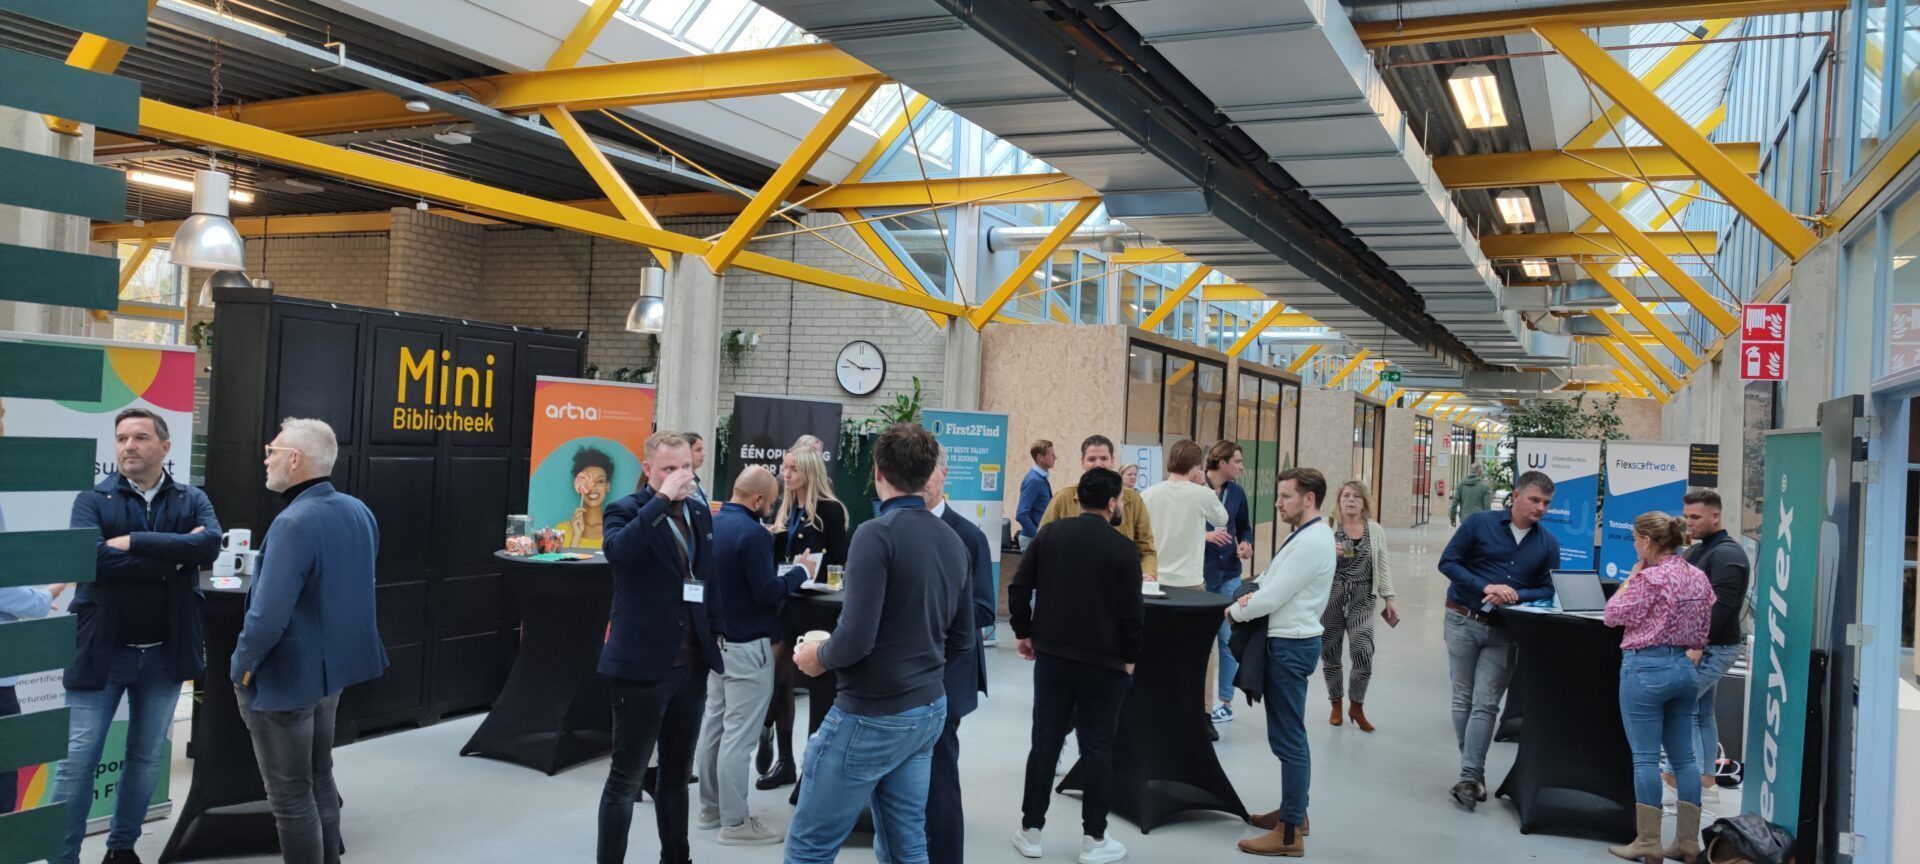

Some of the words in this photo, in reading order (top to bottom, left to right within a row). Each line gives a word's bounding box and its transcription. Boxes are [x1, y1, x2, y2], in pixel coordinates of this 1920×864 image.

[397, 346, 495, 408] Mini
[392, 407, 495, 433] Bibliotheek
[945, 423, 1000, 438] First2Find
[740, 443, 764, 459] ÉÉN
[970, 447, 989, 455] TALENT
[1759, 498, 1794, 823] easyflex
